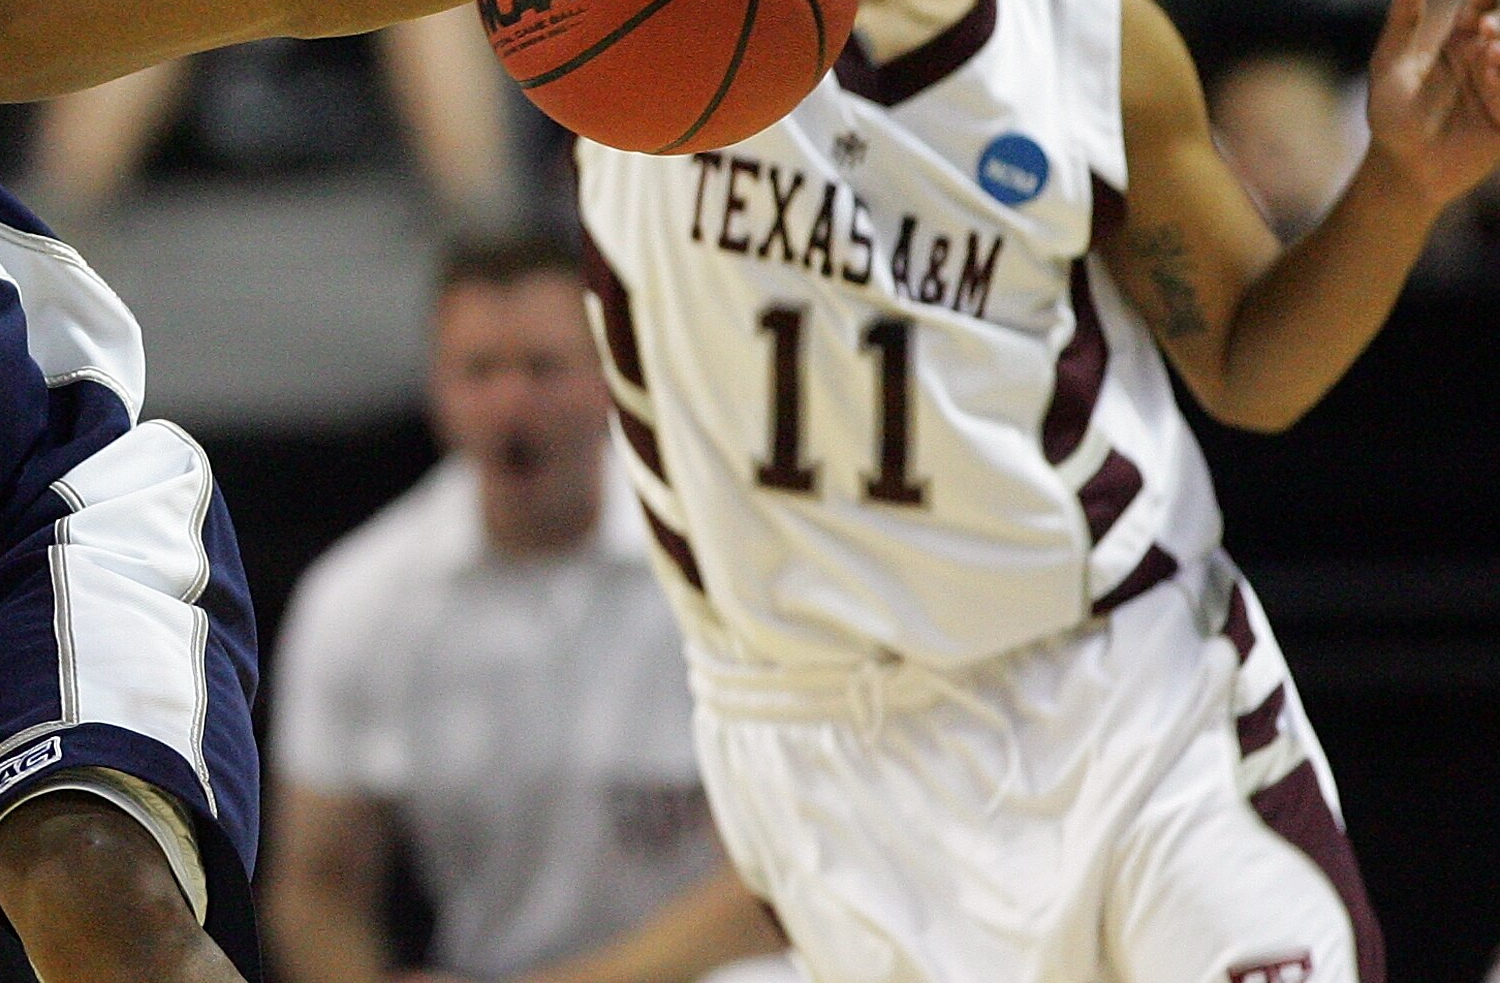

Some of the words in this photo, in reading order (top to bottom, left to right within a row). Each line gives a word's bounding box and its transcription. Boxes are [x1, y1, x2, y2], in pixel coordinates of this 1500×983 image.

[690, 152, 873, 284] TEXAS
[891, 216, 1003, 319] A&M
[754, 300, 927, 507] 11
